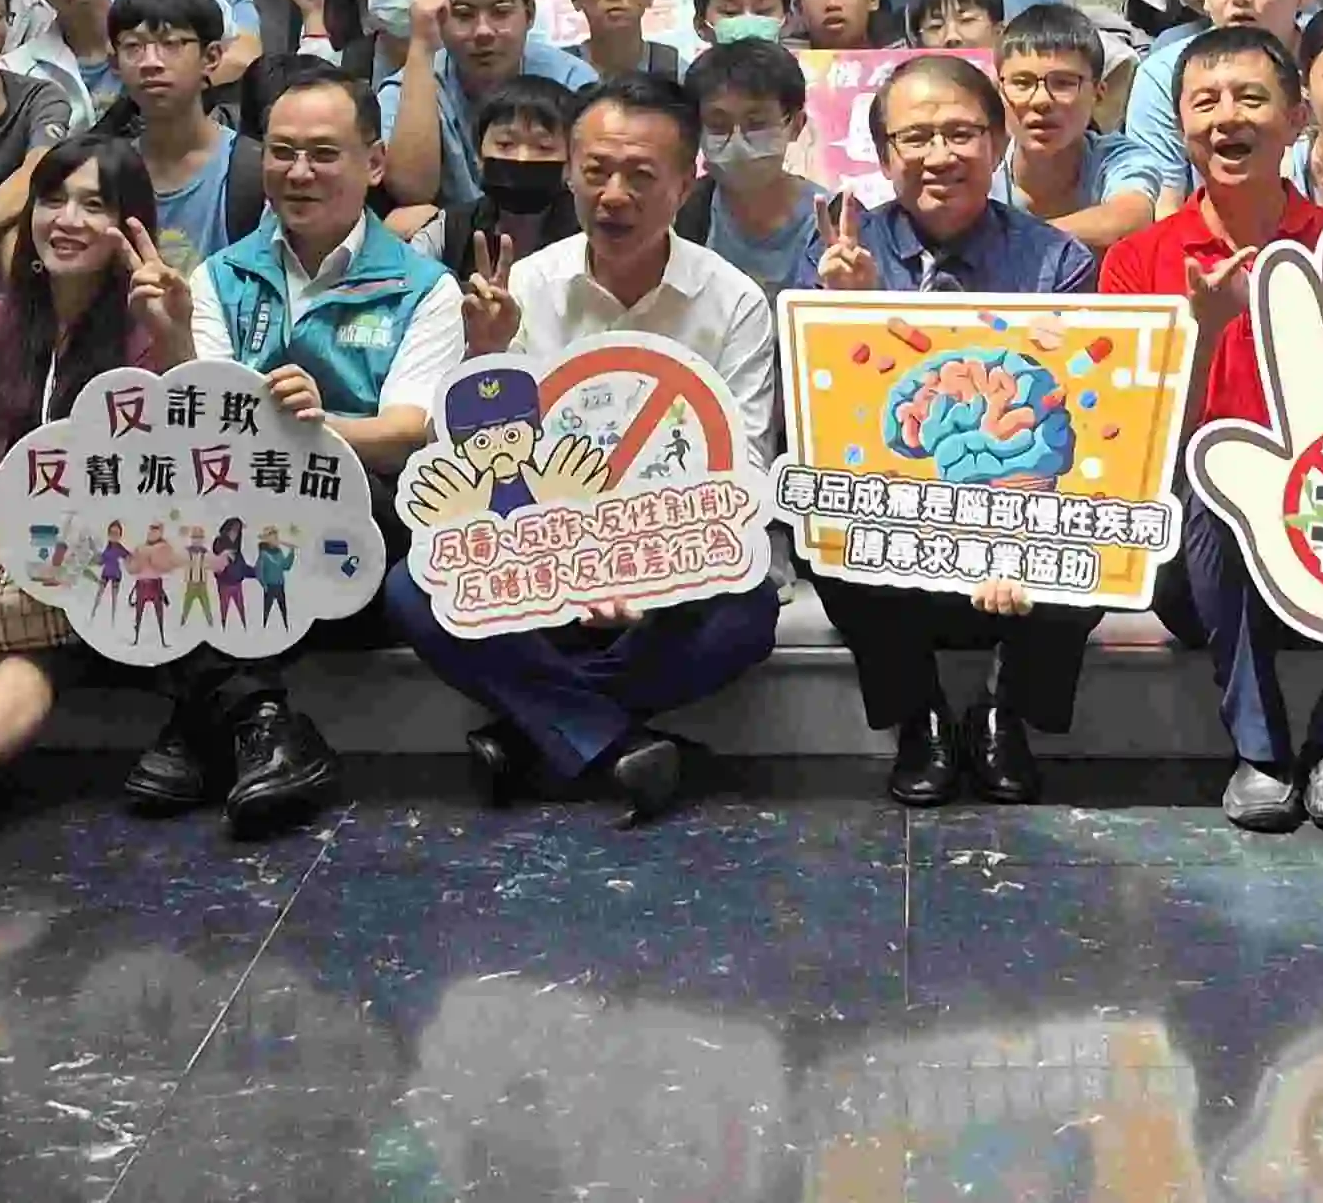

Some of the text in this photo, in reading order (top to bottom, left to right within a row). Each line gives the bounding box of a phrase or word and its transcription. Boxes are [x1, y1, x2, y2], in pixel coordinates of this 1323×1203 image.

[105, 384, 261, 438] 反詐欺
[27, 444, 342, 502] 反幫派反毒品
[780, 469, 1168, 548] 毒品成癮是腦部慢性疾病
[850, 525, 1096, 588] 請尋求專業協助
